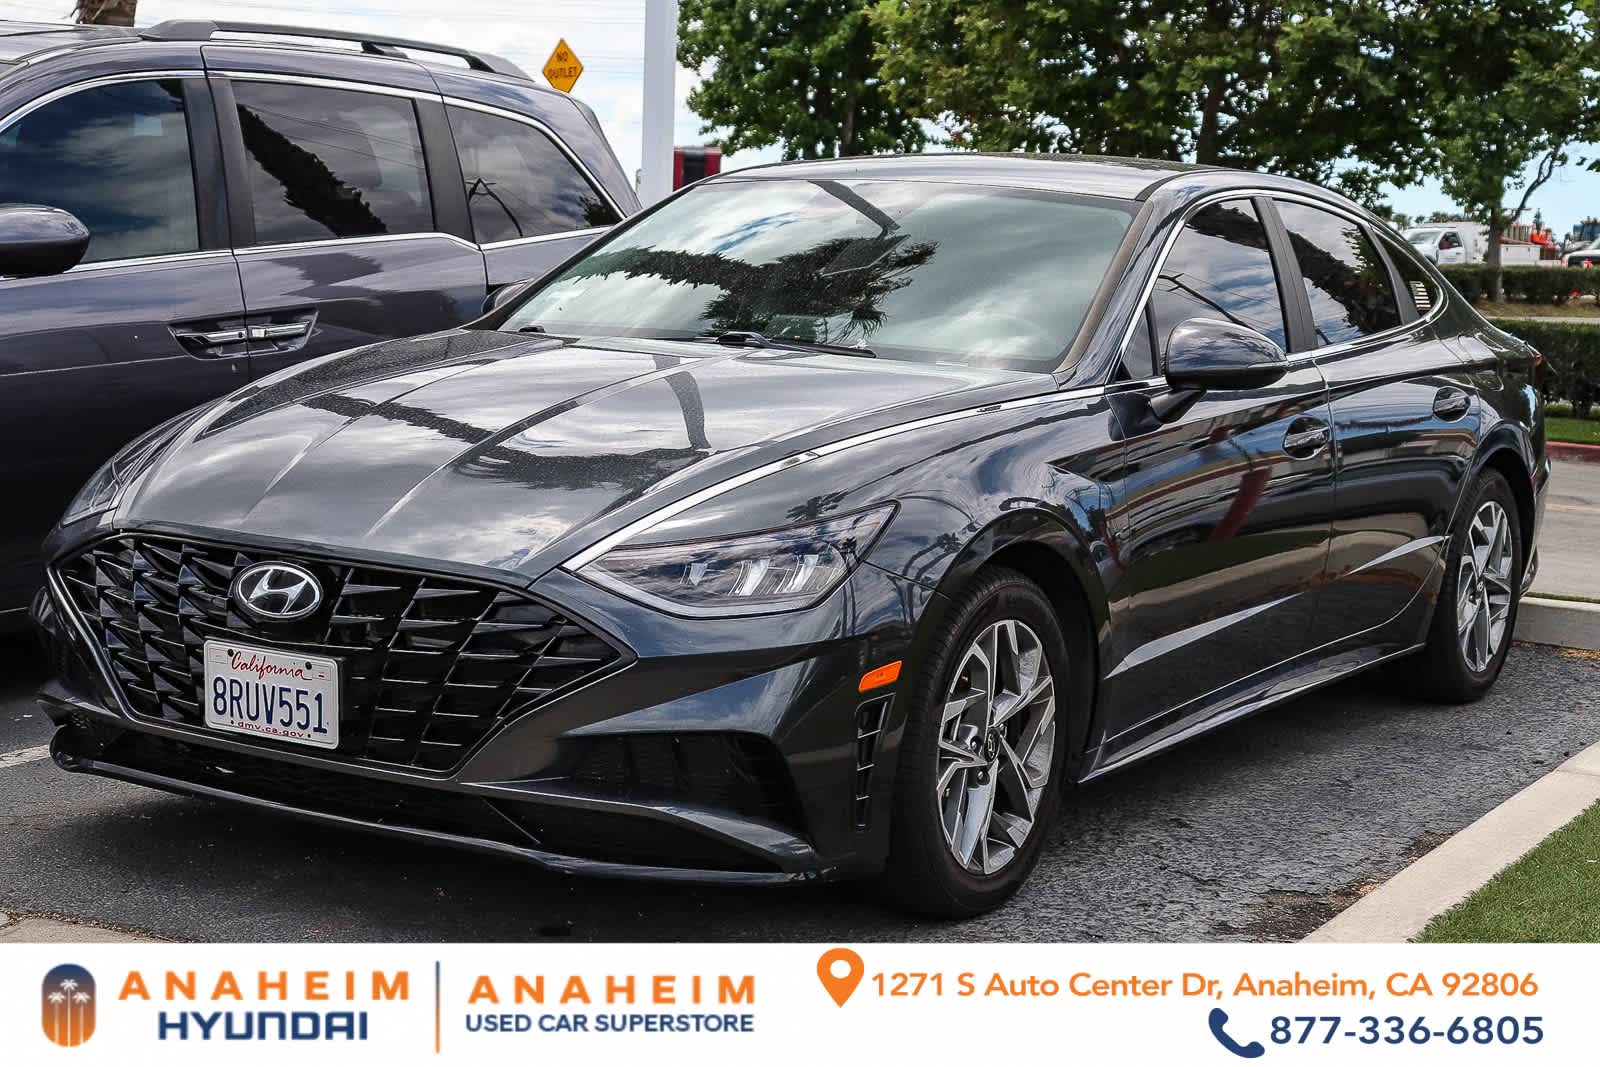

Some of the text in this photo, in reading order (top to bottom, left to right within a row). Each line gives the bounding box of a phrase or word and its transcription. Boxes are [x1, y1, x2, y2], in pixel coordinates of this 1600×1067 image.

[556, 51, 569, 62] NO
[547, 66, 577, 79] OUTLET
[231, 650, 313, 681] California
[213, 676, 328, 734] 8RUV551
[238, 720, 304, 738] dmv.ca.gov
